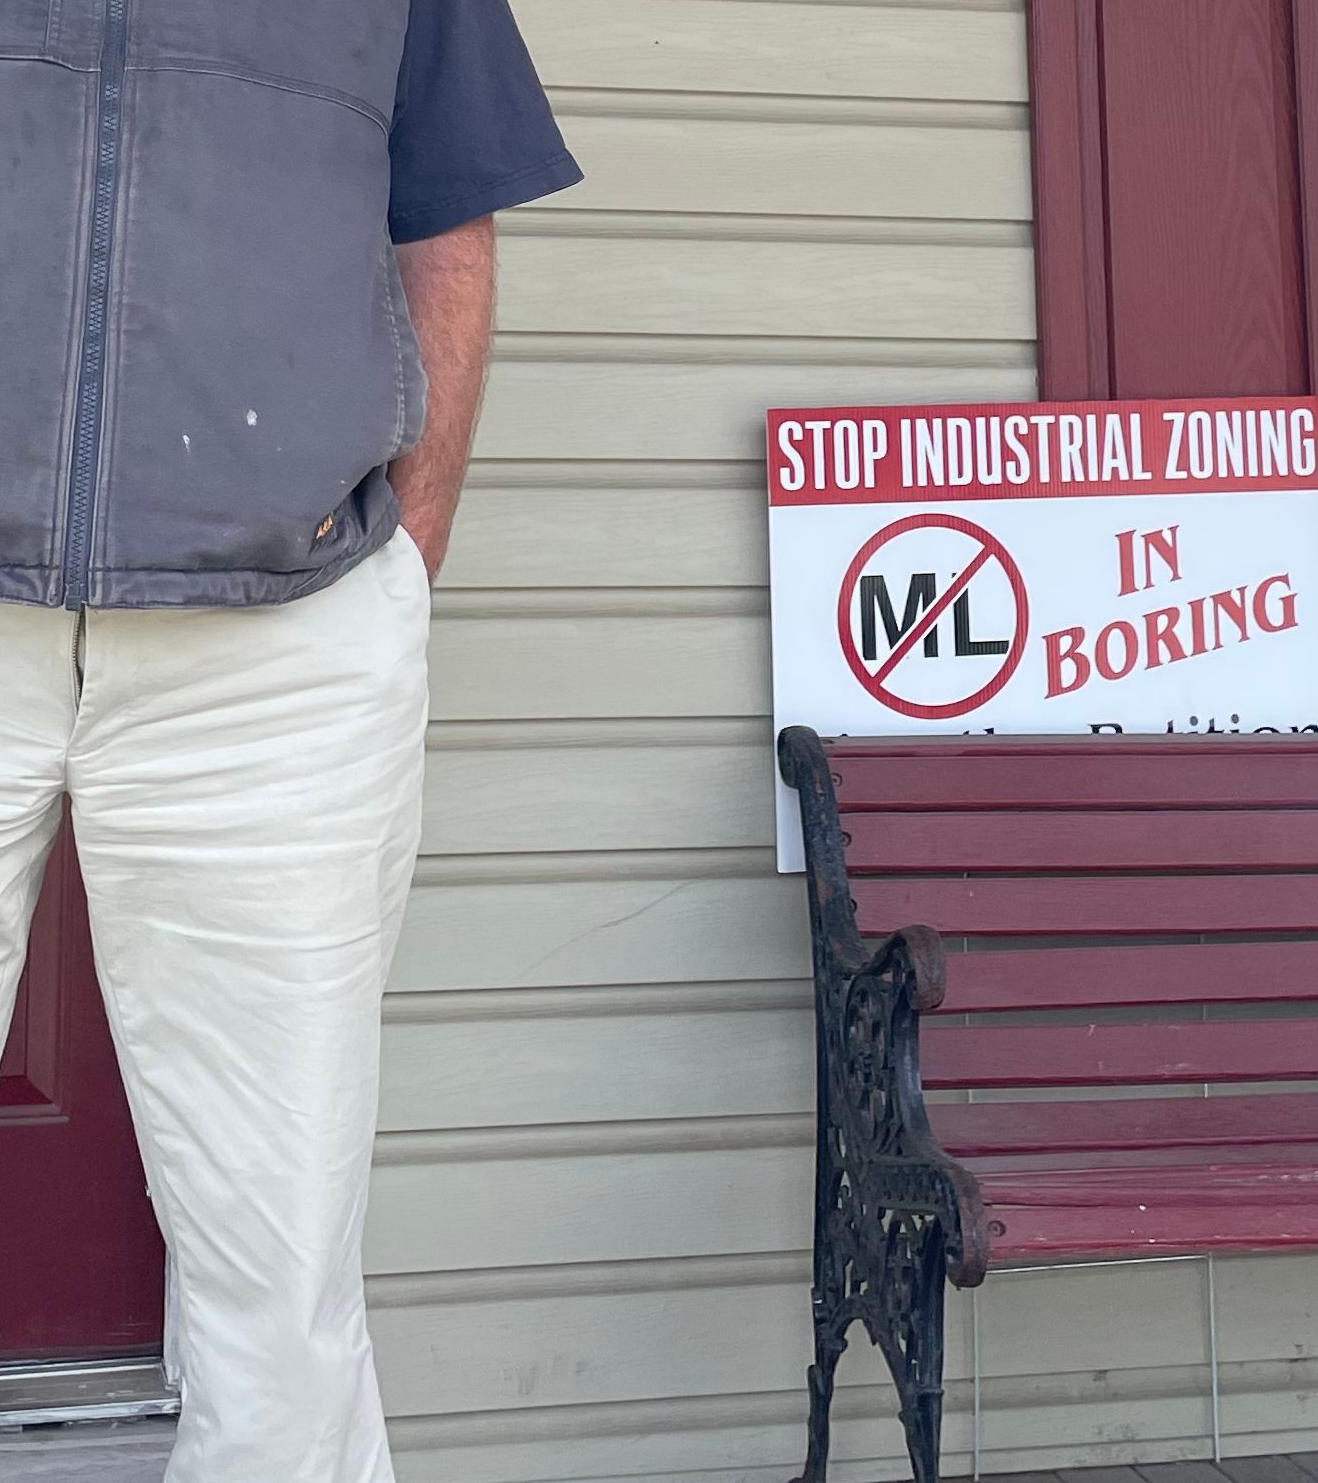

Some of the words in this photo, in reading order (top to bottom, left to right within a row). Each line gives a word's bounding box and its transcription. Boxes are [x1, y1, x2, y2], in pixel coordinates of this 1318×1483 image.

[778, 419, 887, 491] STOP
[902, 411, 1152, 488] INDUSTRIAL
[1162, 408, 1316, 480] ZONING
[1115, 525, 1182, 597] IN
[860, 571, 1009, 662] ML
[1041, 573, 1298, 699] BORING
